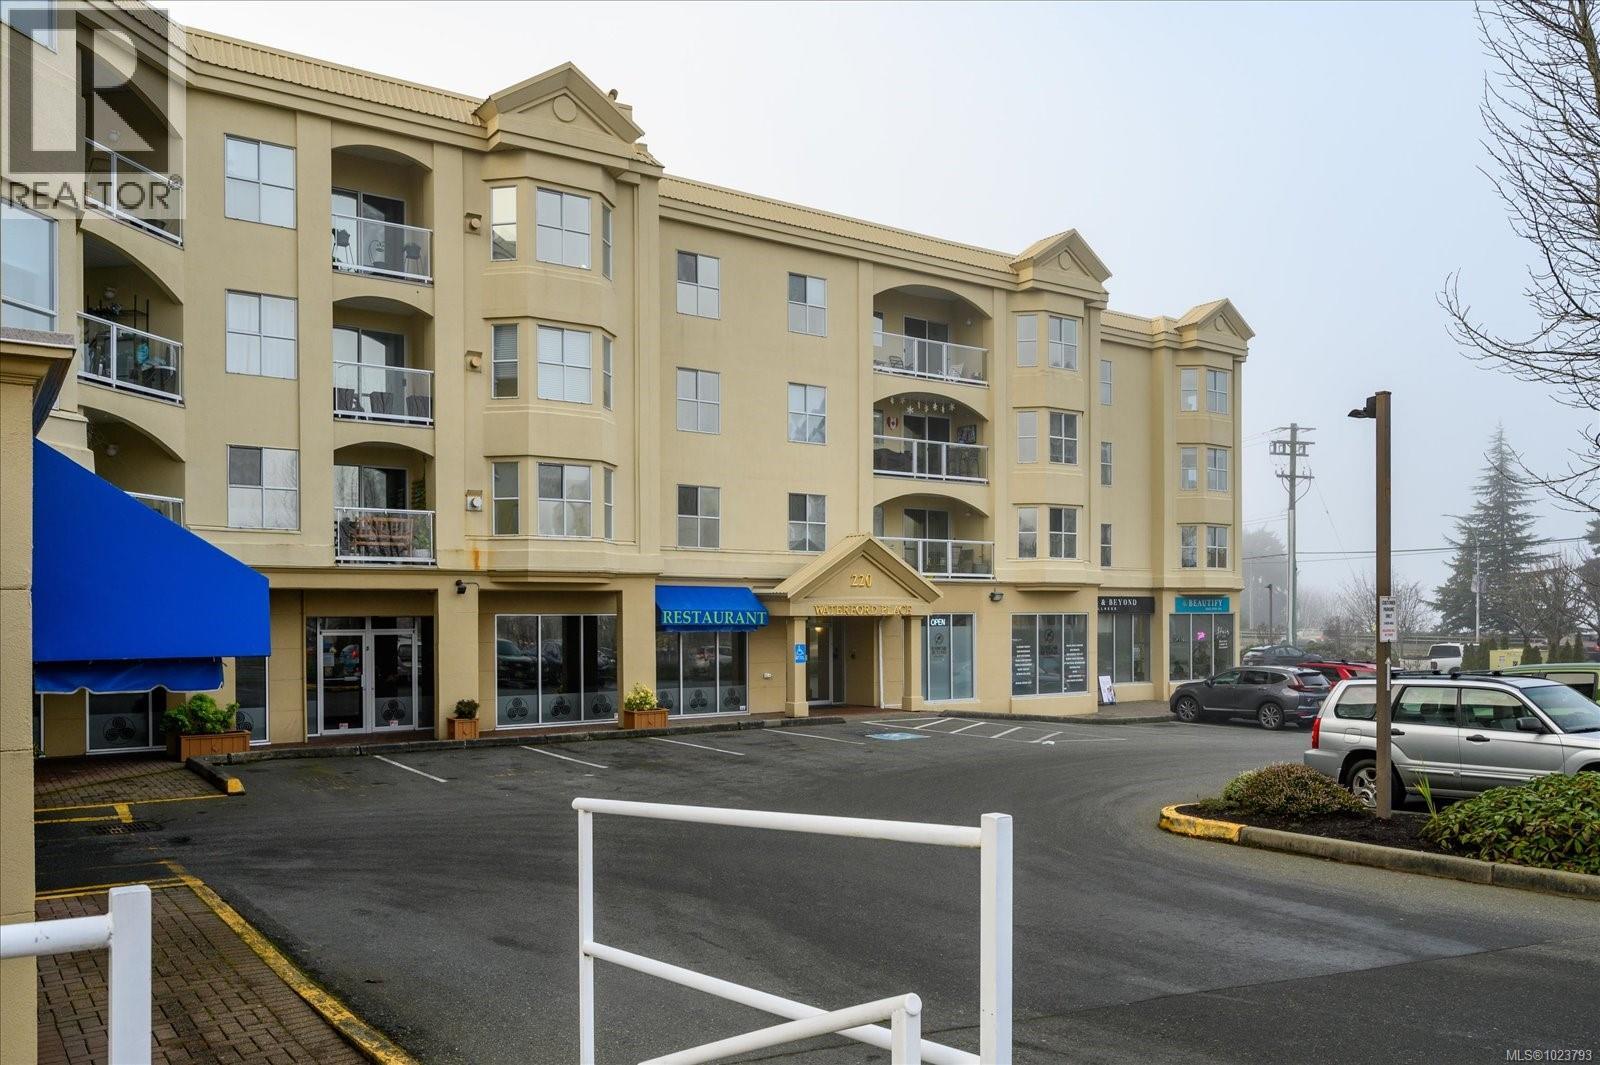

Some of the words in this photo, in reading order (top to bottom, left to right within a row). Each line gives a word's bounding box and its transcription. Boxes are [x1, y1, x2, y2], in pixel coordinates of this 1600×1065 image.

[850, 574, 872, 588] 220
[1188, 599, 1223, 607] BEAUTIFY
[814, 604, 877, 616] WATERFORD
[880, 604, 913, 615] PLACE
[662, 610, 768, 625] RESTAURANT
[930, 618, 946, 626] OPEN
